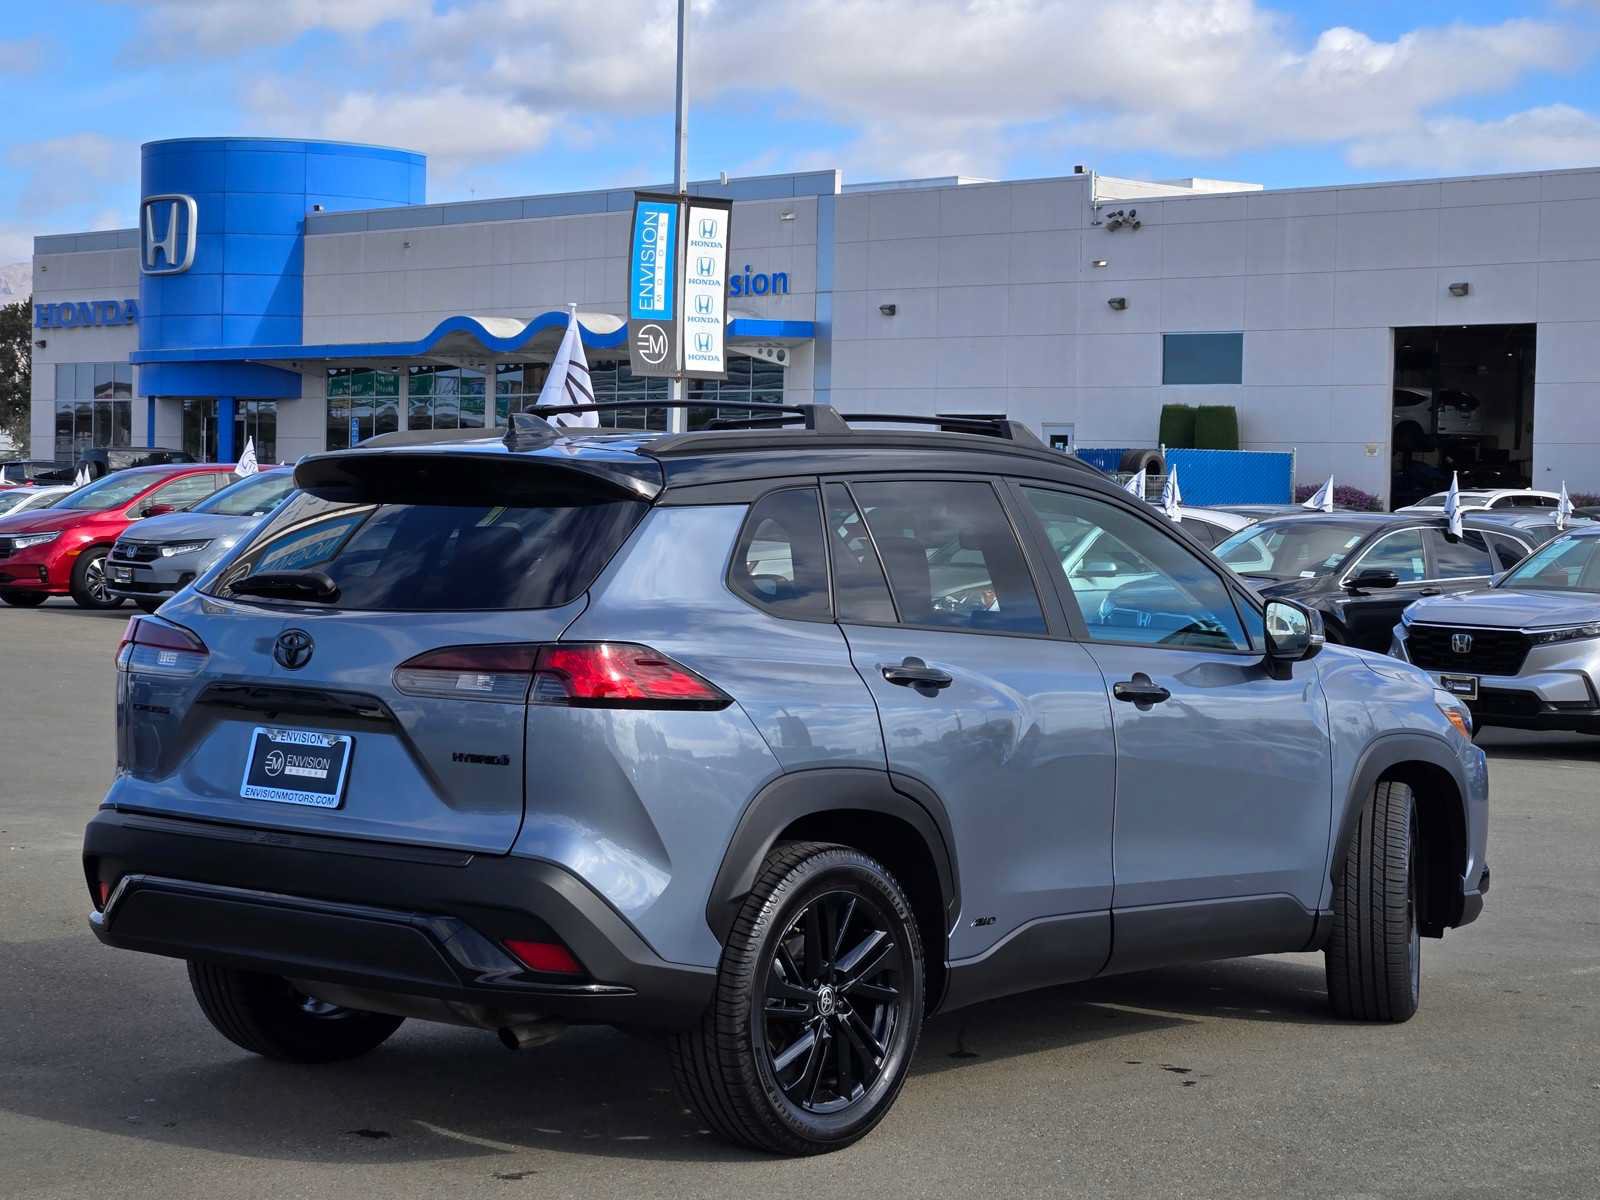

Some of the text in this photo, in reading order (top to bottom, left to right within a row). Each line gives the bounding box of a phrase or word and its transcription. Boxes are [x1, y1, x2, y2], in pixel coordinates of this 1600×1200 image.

[691, 240, 723, 249] HONDA
[639, 211, 658, 311] ENVISION
[656, 221, 667, 303] MOTORS
[688, 278, 721, 287] HONDA
[729, 264, 789, 297] sion
[34, 299, 138, 328] HONDA
[687, 316, 720, 325] HONDA
[688, 353, 720, 362] HONDA
[281, 731, 323, 745] ENVISION
[286, 754, 331, 769] ENVISION
[245, 787, 334, 805] ENVISIONMOTORS.COM
